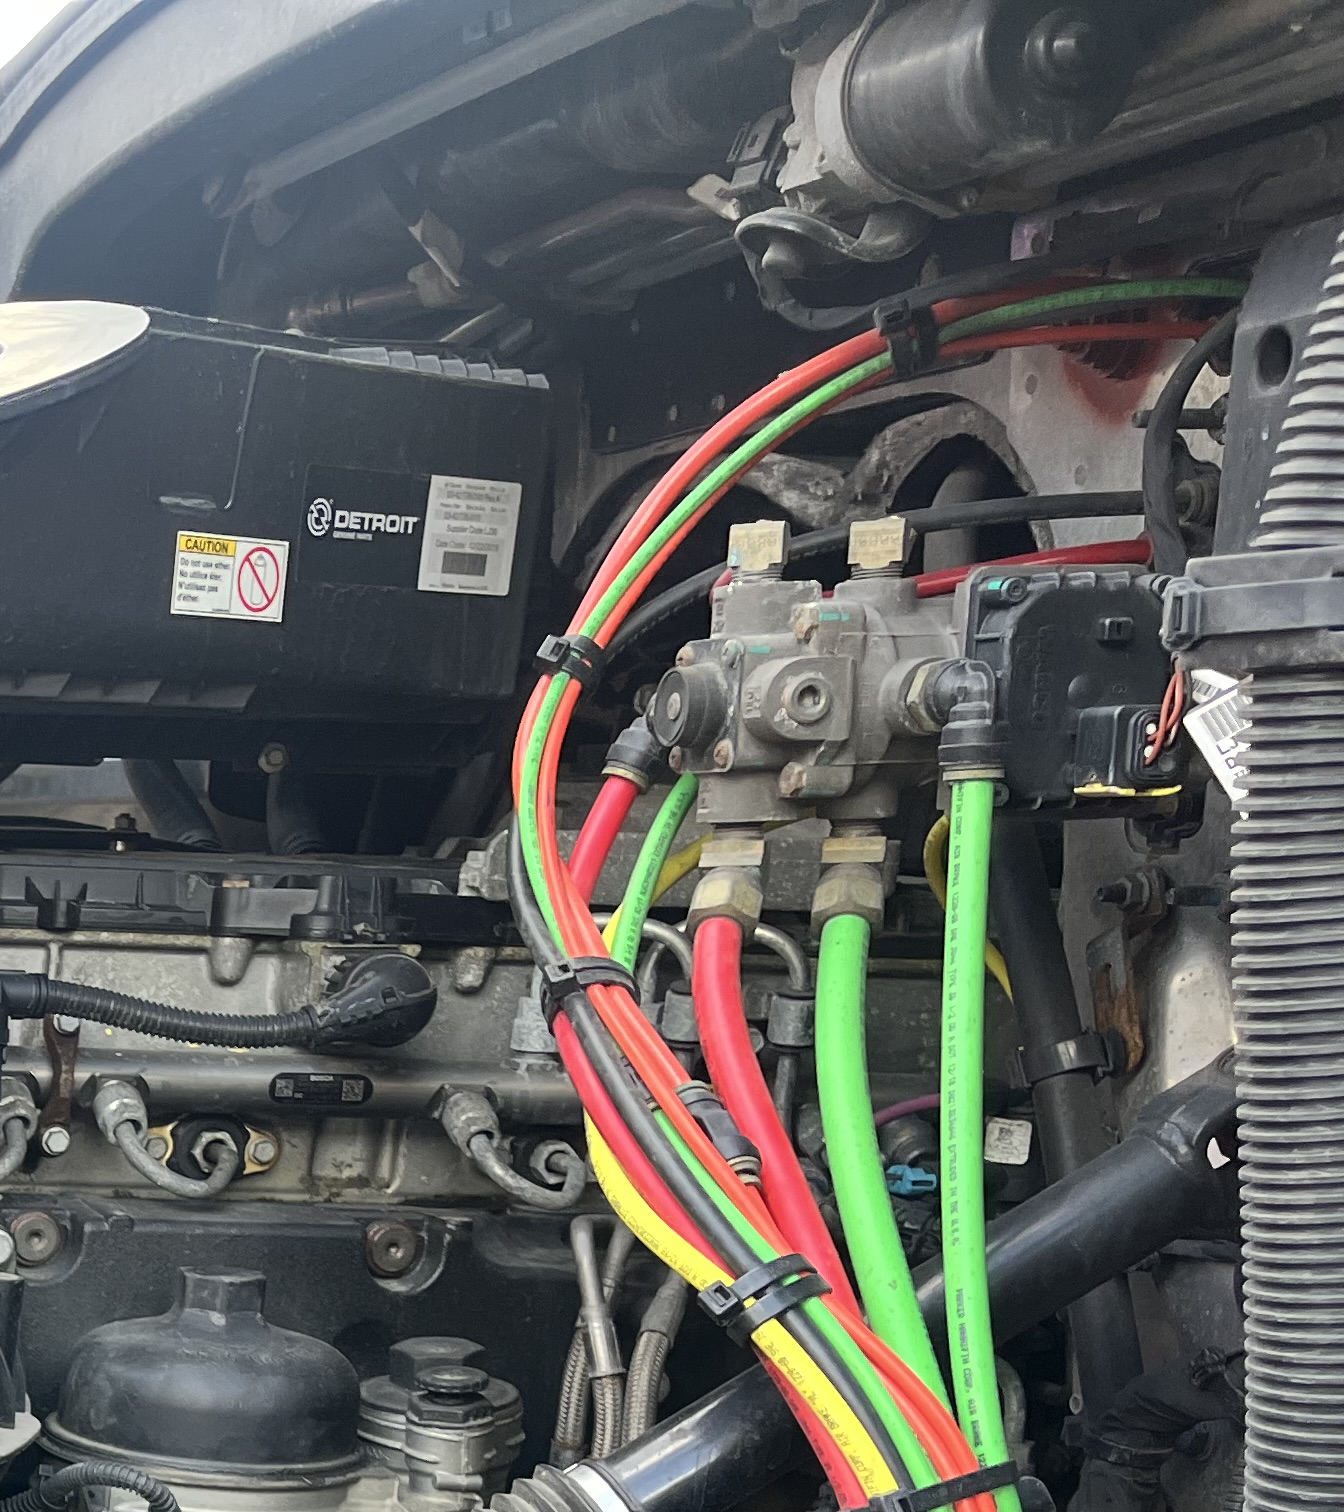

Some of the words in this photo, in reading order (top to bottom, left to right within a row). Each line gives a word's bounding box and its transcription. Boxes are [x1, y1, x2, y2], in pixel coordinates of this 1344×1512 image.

[334, 509, 420, 534] DETROIT
[185, 538, 229, 554] CAUTION
[180, 557, 189, 566] Do
